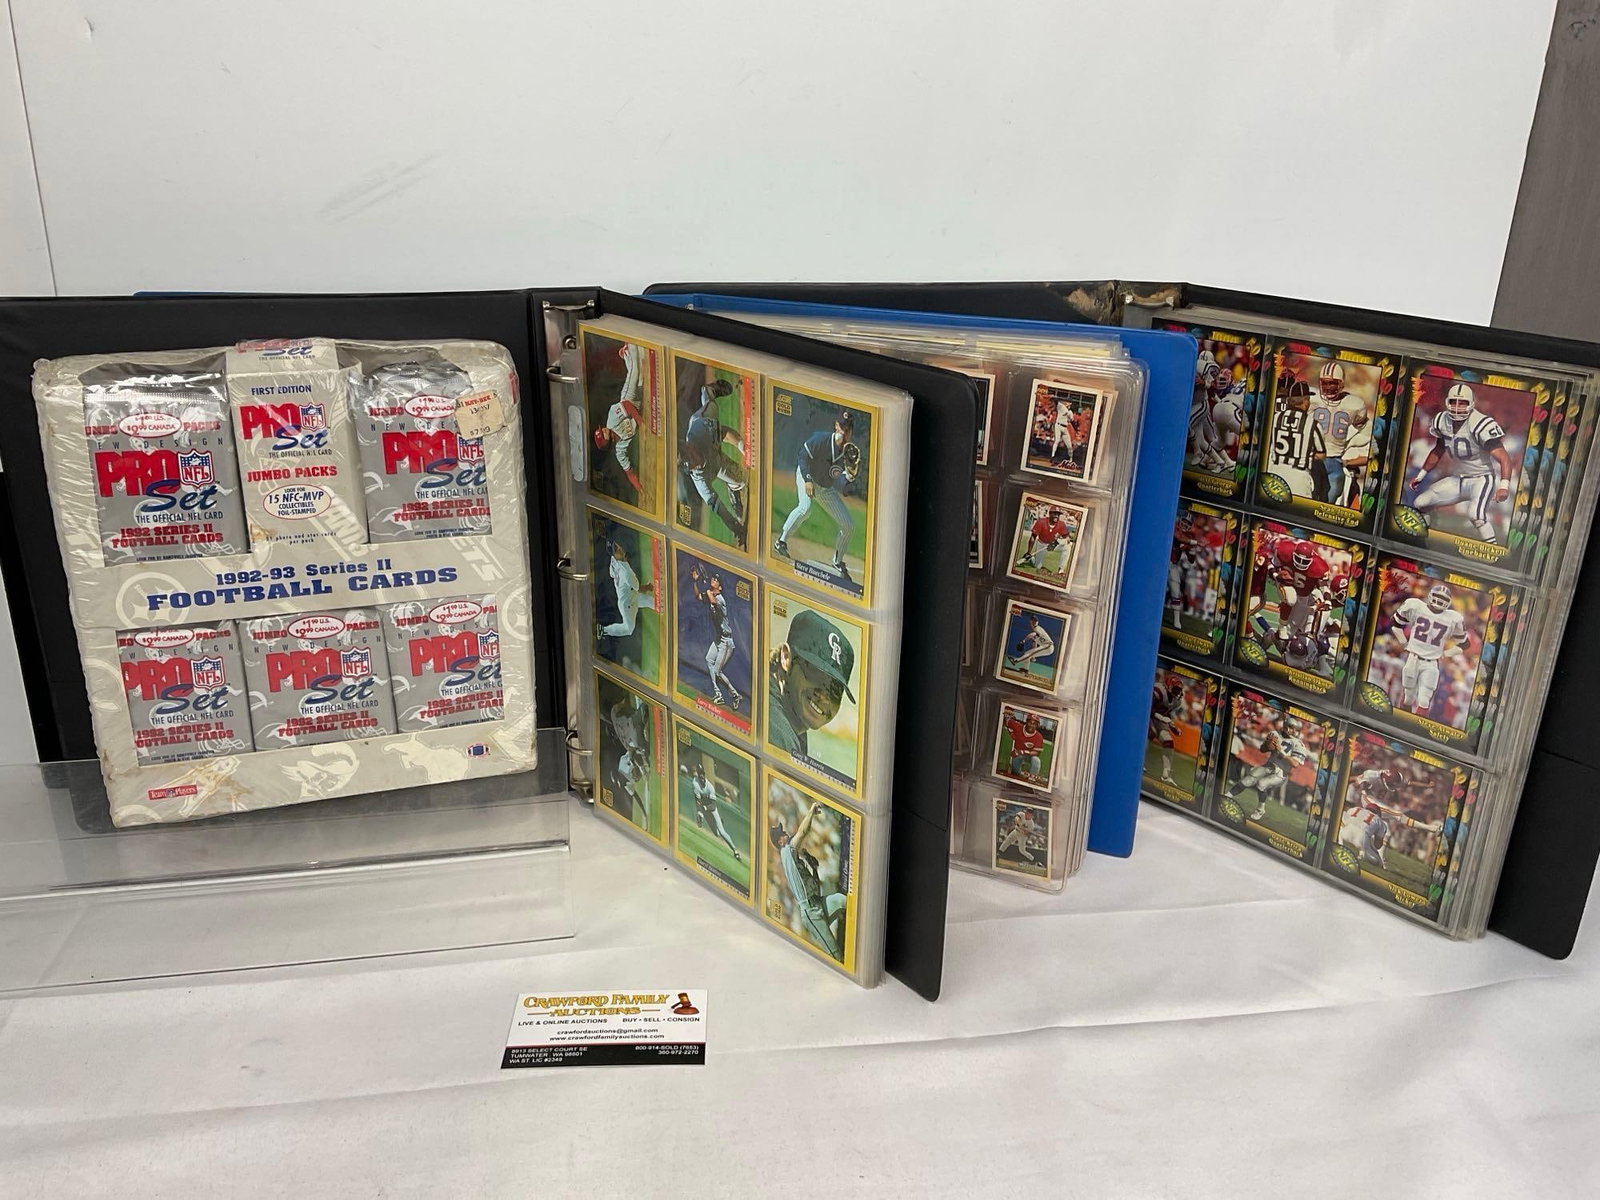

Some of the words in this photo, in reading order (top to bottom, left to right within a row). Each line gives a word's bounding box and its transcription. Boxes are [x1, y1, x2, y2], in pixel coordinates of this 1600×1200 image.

[251, 386, 274, 396] FIRST
[278, 384, 312, 394] EDITION
[239, 402, 301, 440] PRO
[304, 414, 324, 428] NFL
[272, 426, 329, 450] Set
[1276, 430, 1302, 458] 51
[318, 448, 332, 456] CARD
[382, 430, 458, 475] PRO
[461, 444, 484, 458] NFL
[94, 449, 180, 497] PRO
[183, 466, 211, 481] NFL
[248, 468, 291, 482] JUMBO
[295, 466, 338, 478] PACKS
[421, 458, 486, 488] Set
[416, 491, 430, 499] THE
[432, 489, 460, 498] OFFICIAL
[463, 488, 474, 496] NFL
[1267, 479, 1284, 496] NFL
[140, 479, 219, 513] Set
[269, 494, 280, 504] 15
[282, 491, 324, 502] NFC-MVP
[278, 501, 314, 510] COLLECTIBLES
[278, 508, 316, 516] FOIL-STAMPED
[432, 499, 473, 510] SERIES
[136, 514, 150, 524] THE
[152, 513, 185, 524] OFFICIAL
[188, 512, 202, 520] NFL
[204, 511, 224, 520] CARD
[393, 510, 454, 522] FOOTBALL
[1314, 509, 1345, 524] Defensive
[1346, 516, 1359, 526] End
[1401, 512, 1418, 531] NFL
[120, 526, 151, 538] 1992
[154, 524, 200, 536] SERIES
[112, 536, 178, 549] FOOTBALL
[182, 532, 224, 544] CARDS
[1458, 546, 1499, 562] Linebacker
[216, 566, 295, 586] 1992-93
[307, 562, 368, 576] Series
[376, 558, 392, 572] II
[796, 560, 810, 573] Steve
[147, 579, 332, 610] FOOTBALL
[348, 567, 458, 592] CARDS
[396, 616, 429, 626] JUMBO
[454, 610, 477, 618] CANADA
[346, 620, 379, 631] PACKS
[1414, 616, 1448, 646] 27
[196, 630, 231, 640] PACKS
[253, 630, 288, 640] JUMBO
[409, 631, 479, 677] PRO
[266, 648, 341, 692] PRO
[345, 662, 368, 674] NFL
[120, 657, 194, 701] PRO
[196, 670, 220, 684] NFL
[305, 674, 375, 704] Set
[454, 685, 480, 694] OFFICIAL
[1288, 676, 1327, 694] Runningback
[156, 684, 228, 714] Set
[428, 698, 452, 710] 1992
[456, 691, 494, 704] SERIES
[1368, 690, 1385, 706] NFL
[301, 706, 314, 714] THE
[316, 704, 345, 714] OFFICIAL
[348, 702, 360, 710] NFL
[362, 700, 378, 708] CARD
[420, 703, 475, 718] FOOTBALL
[151, 717, 164, 726] THE
[167, 714, 198, 724] OFFICIAL
[200, 712, 214, 720] NFL
[216, 710, 234, 718] CARD
[286, 716, 313, 728] 1992
[316, 712, 358, 724] SERIES
[136, 728, 165, 739] 1992
[168, 723, 212, 736] SERIES
[194, 729, 234, 741] CARDS
[278, 723, 338, 737] FOOTBALL
[341, 718, 378, 730] CARDS
[1429, 729, 1450, 742] Safety
[524, 996, 610, 1009] CRAWFORD
[611, 994, 670, 1005] FAMILY
[550, 1007, 641, 1017] AUCTIONS
